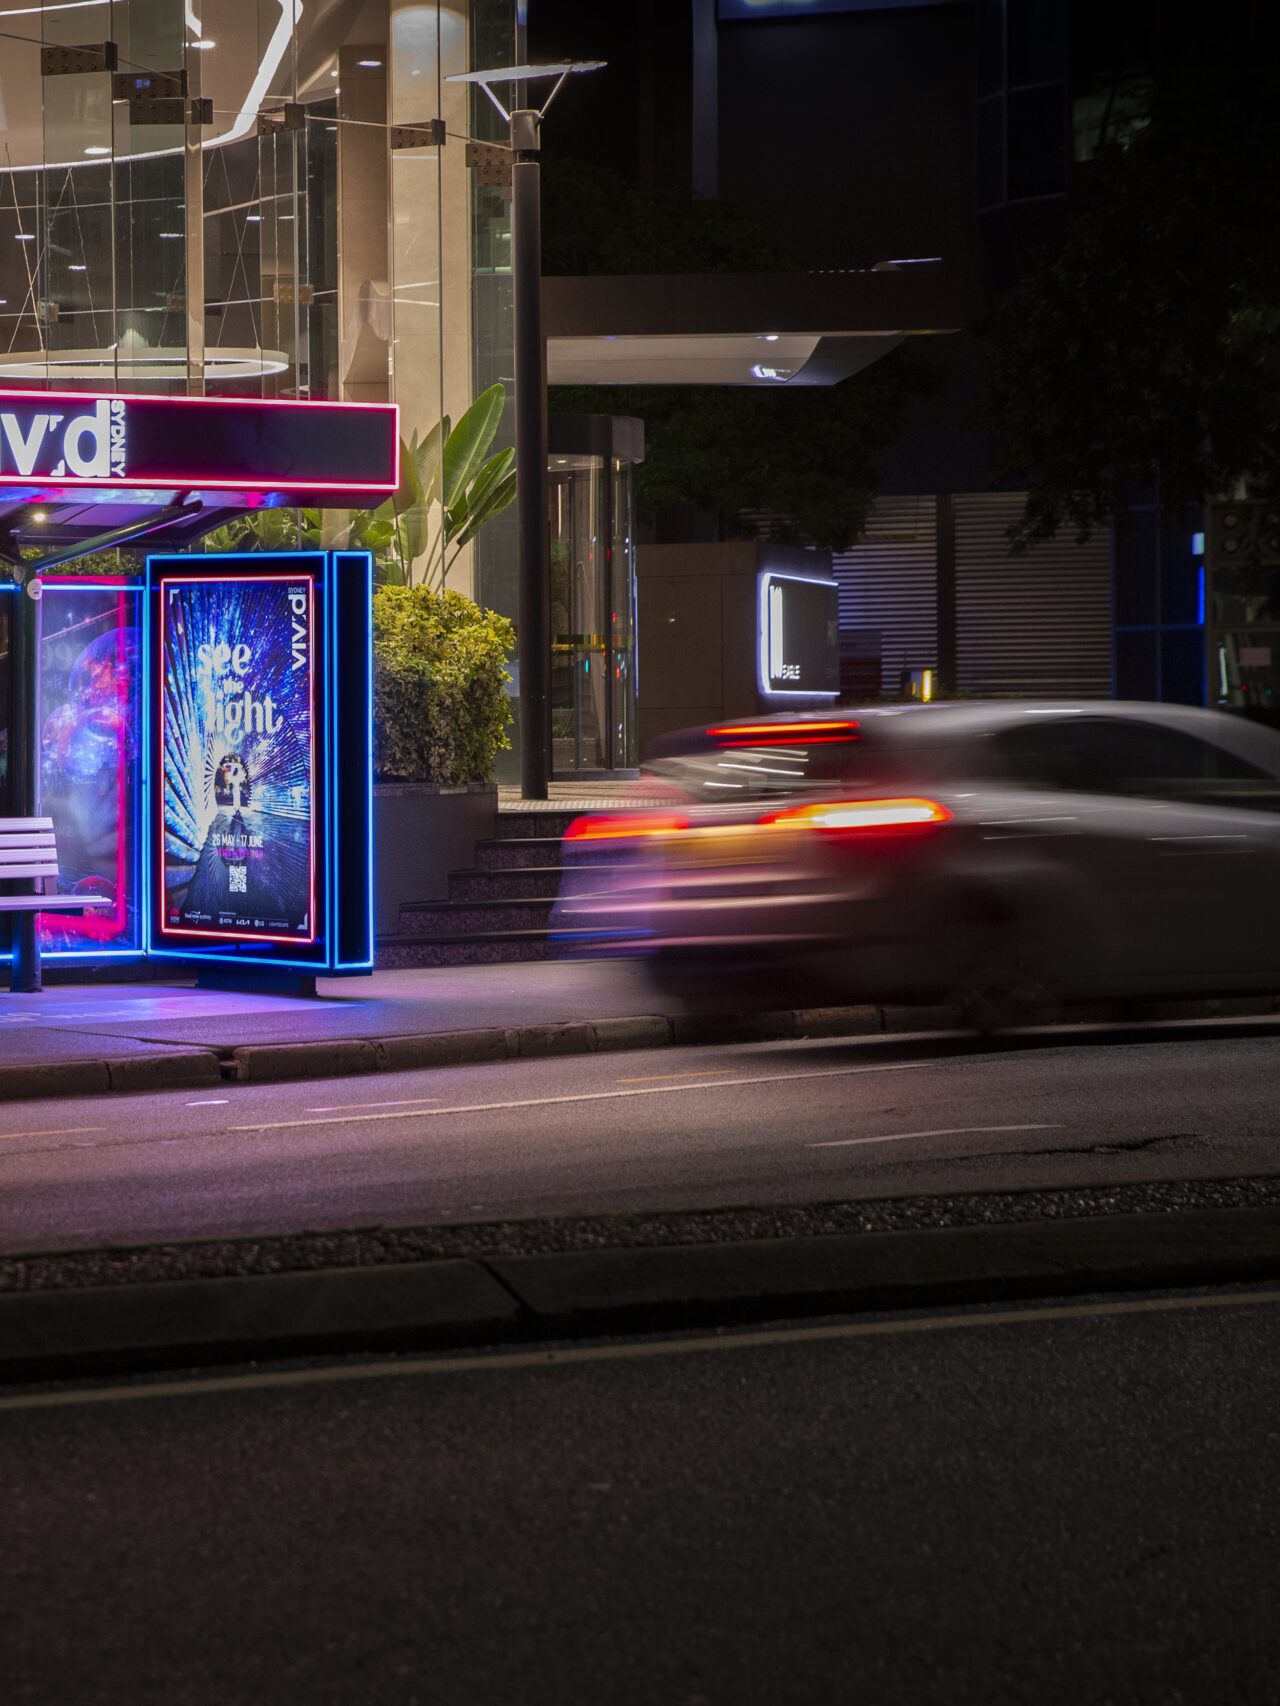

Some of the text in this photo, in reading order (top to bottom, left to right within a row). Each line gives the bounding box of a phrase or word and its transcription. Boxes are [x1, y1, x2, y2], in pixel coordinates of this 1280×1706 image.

[111, 399, 126, 478] SYDNEY
[197, 643, 252, 676] see
[223, 677, 245, 693] the
[204, 686, 284, 745] light
[212, 834, 221, 846] 26
[222, 834, 235, 847] MAY
[240, 834, 248, 847] 17
[248, 835, 264, 848] JUNE
